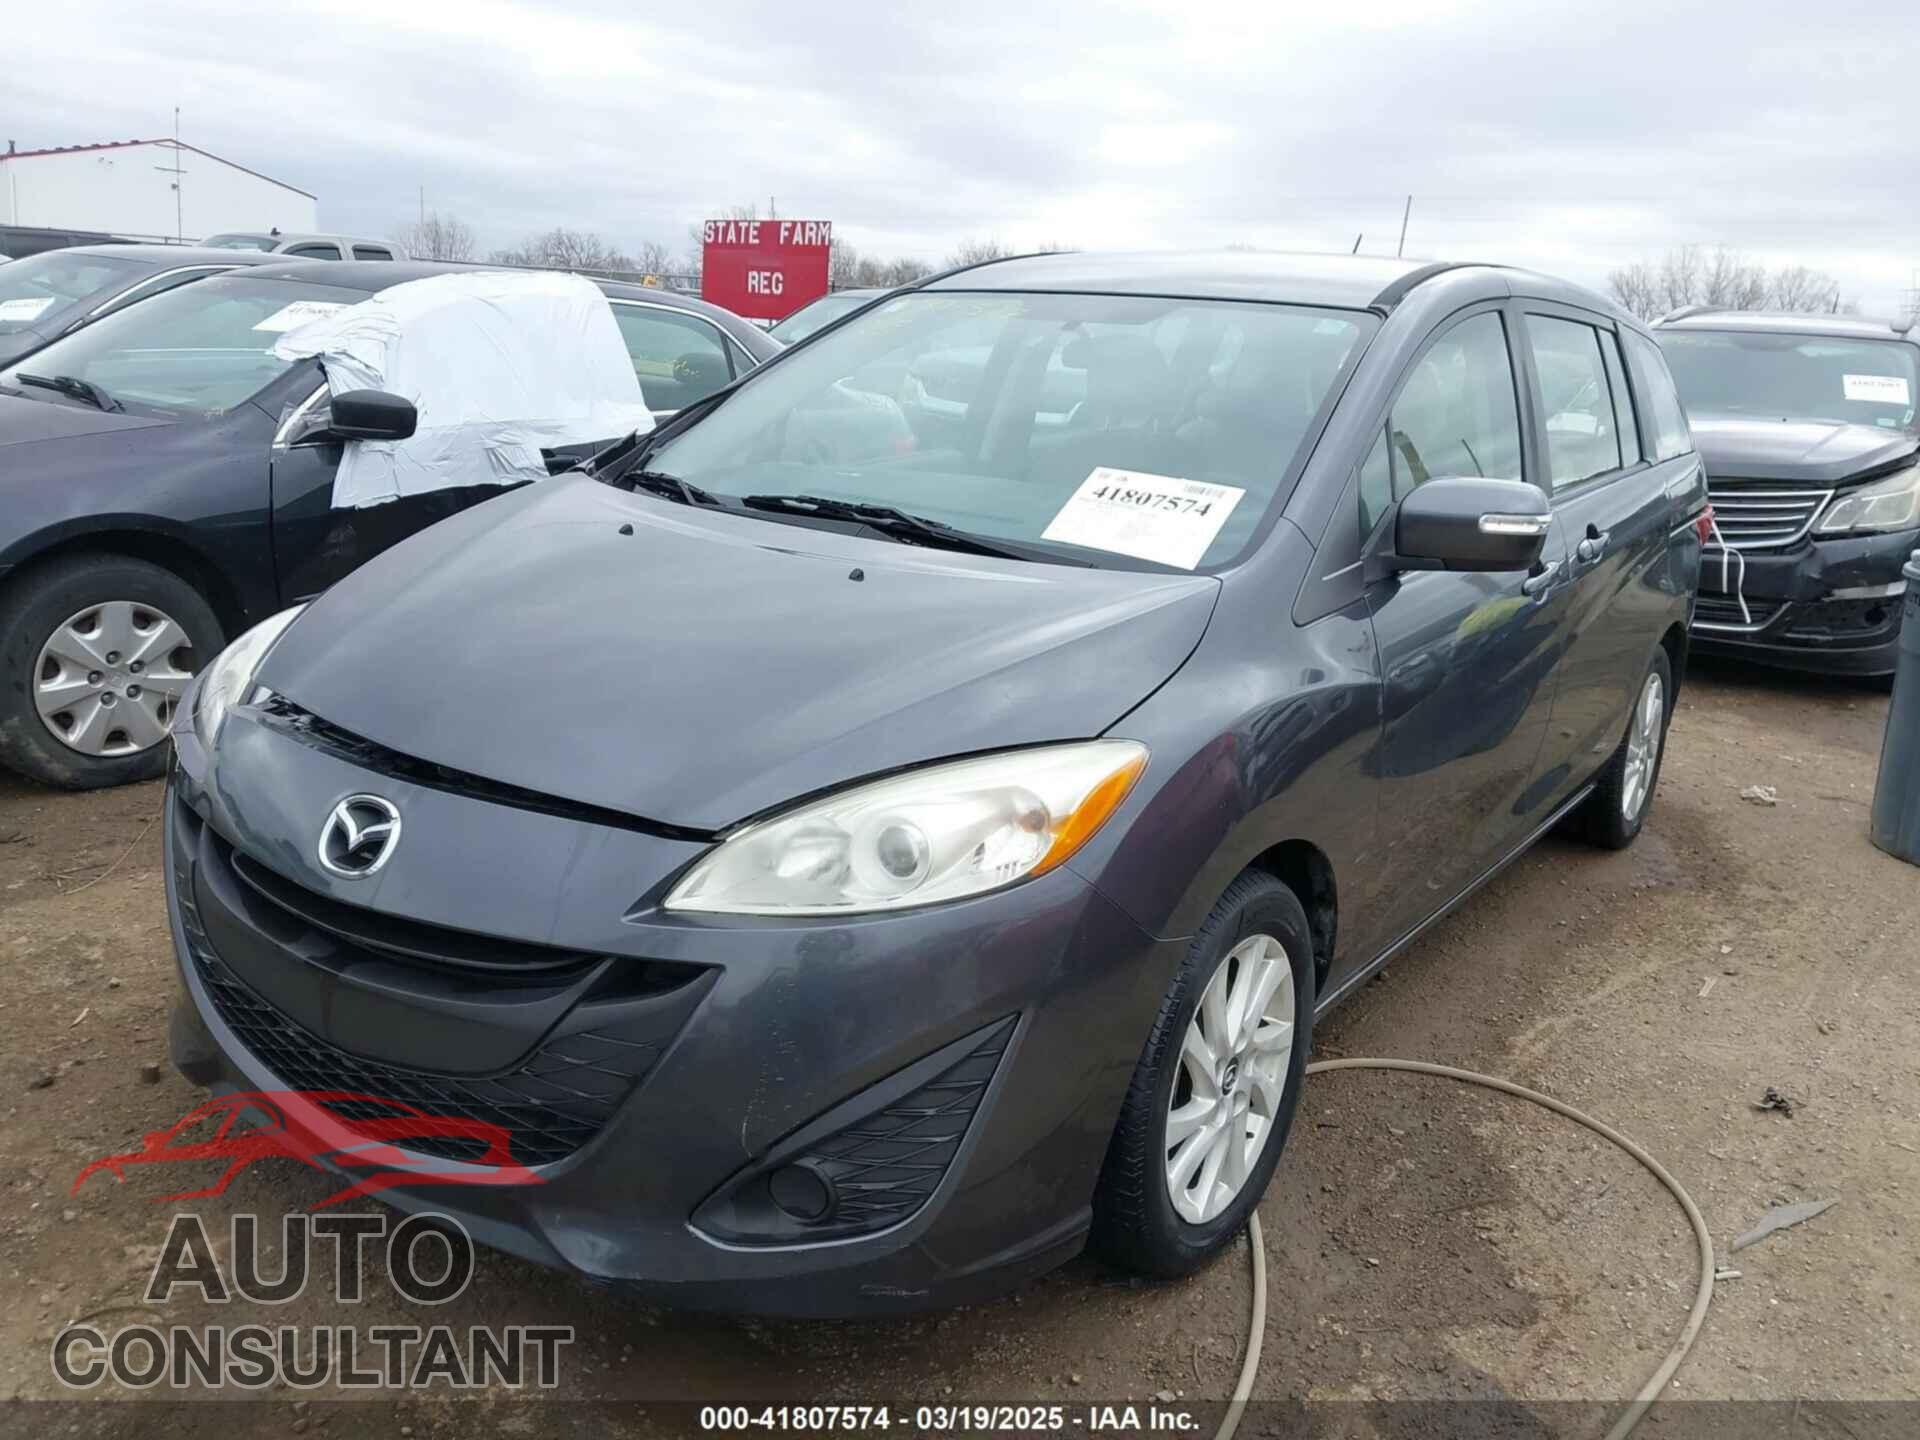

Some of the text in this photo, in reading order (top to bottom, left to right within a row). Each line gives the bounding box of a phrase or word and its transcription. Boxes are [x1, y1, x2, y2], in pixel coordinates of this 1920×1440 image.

[704, 221, 830, 246] STATE FARM
[748, 270, 783, 294] REG
[1092, 485, 1213, 517] 41807574
